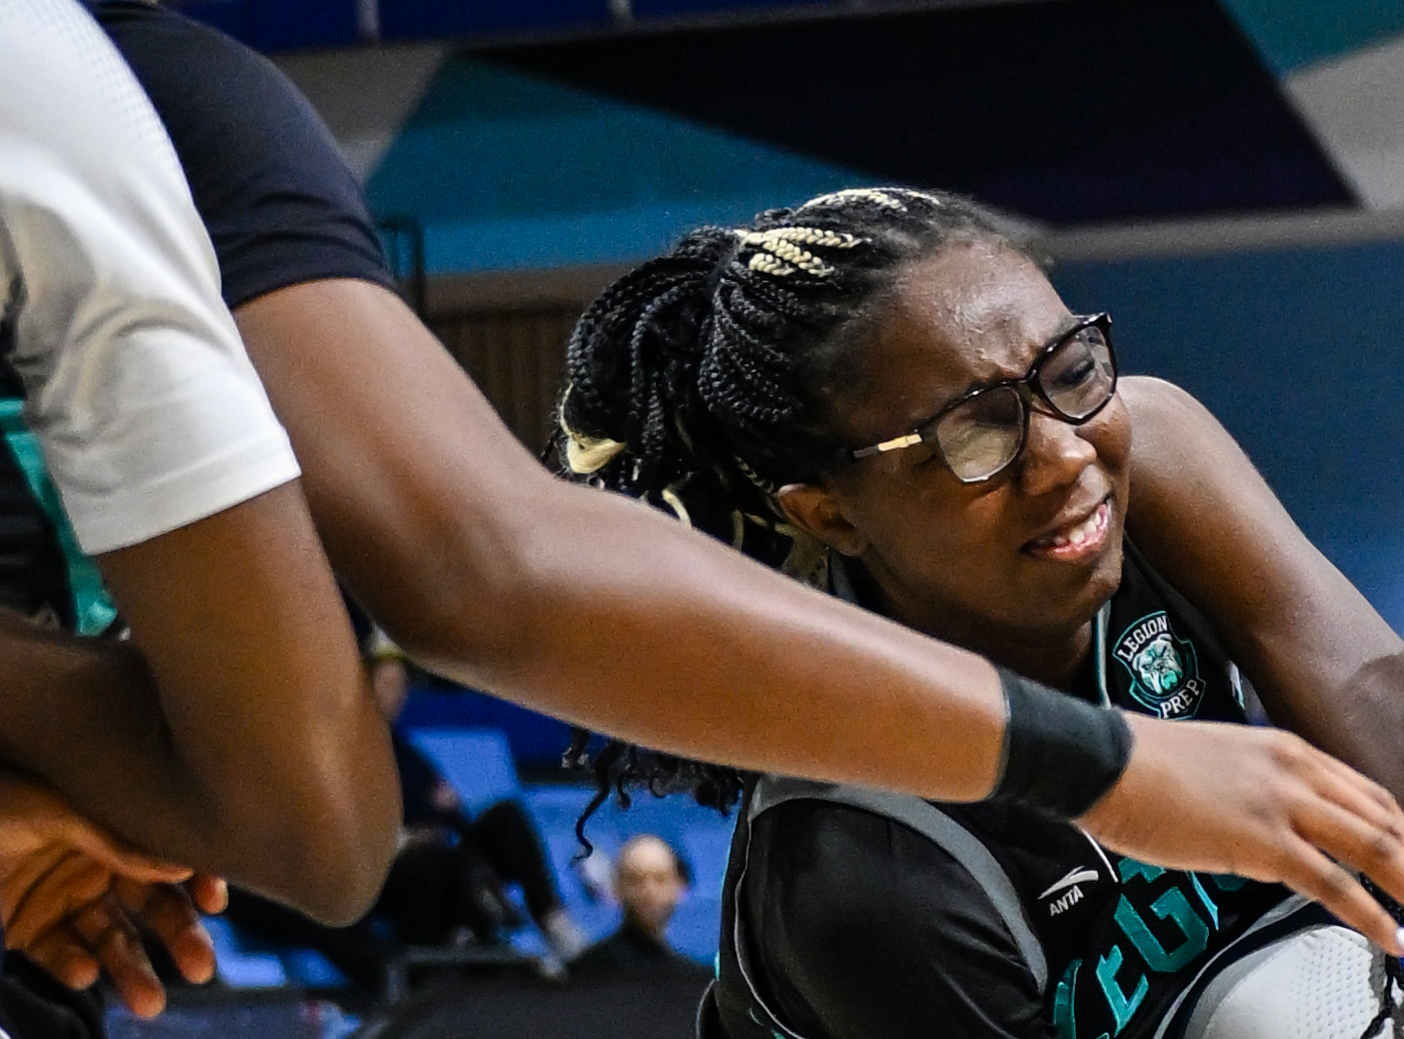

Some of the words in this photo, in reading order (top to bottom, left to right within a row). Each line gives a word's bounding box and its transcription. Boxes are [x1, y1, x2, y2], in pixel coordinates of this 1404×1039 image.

[1117, 614, 1169, 663] LEGION
[1159, 678, 1200, 719] PREP
[1050, 884, 1085, 917] ANTA
